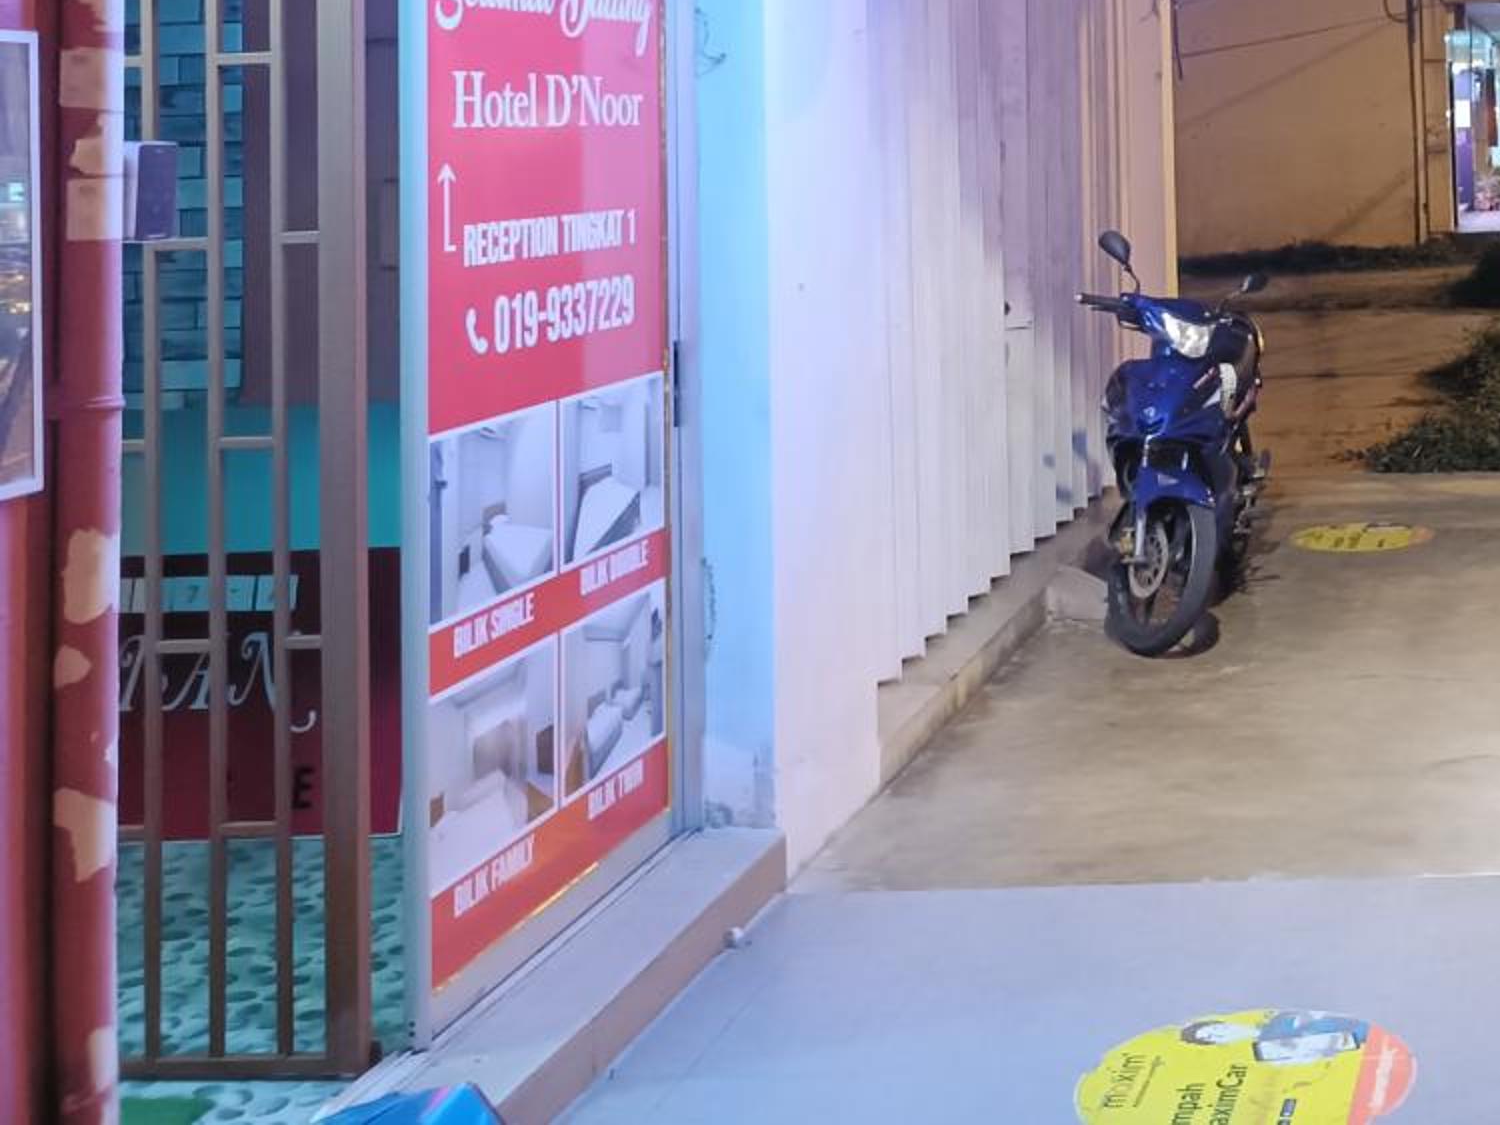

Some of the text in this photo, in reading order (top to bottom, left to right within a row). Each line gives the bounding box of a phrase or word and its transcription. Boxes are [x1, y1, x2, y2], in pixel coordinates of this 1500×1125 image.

[452, 70, 643, 129] Hotel D'Noor
[463, 209, 636, 267] RECEPTION TINGKAT 1
[494, 274, 636, 355] 019-9337229
[1103, 1052, 1147, 1110] maxim
